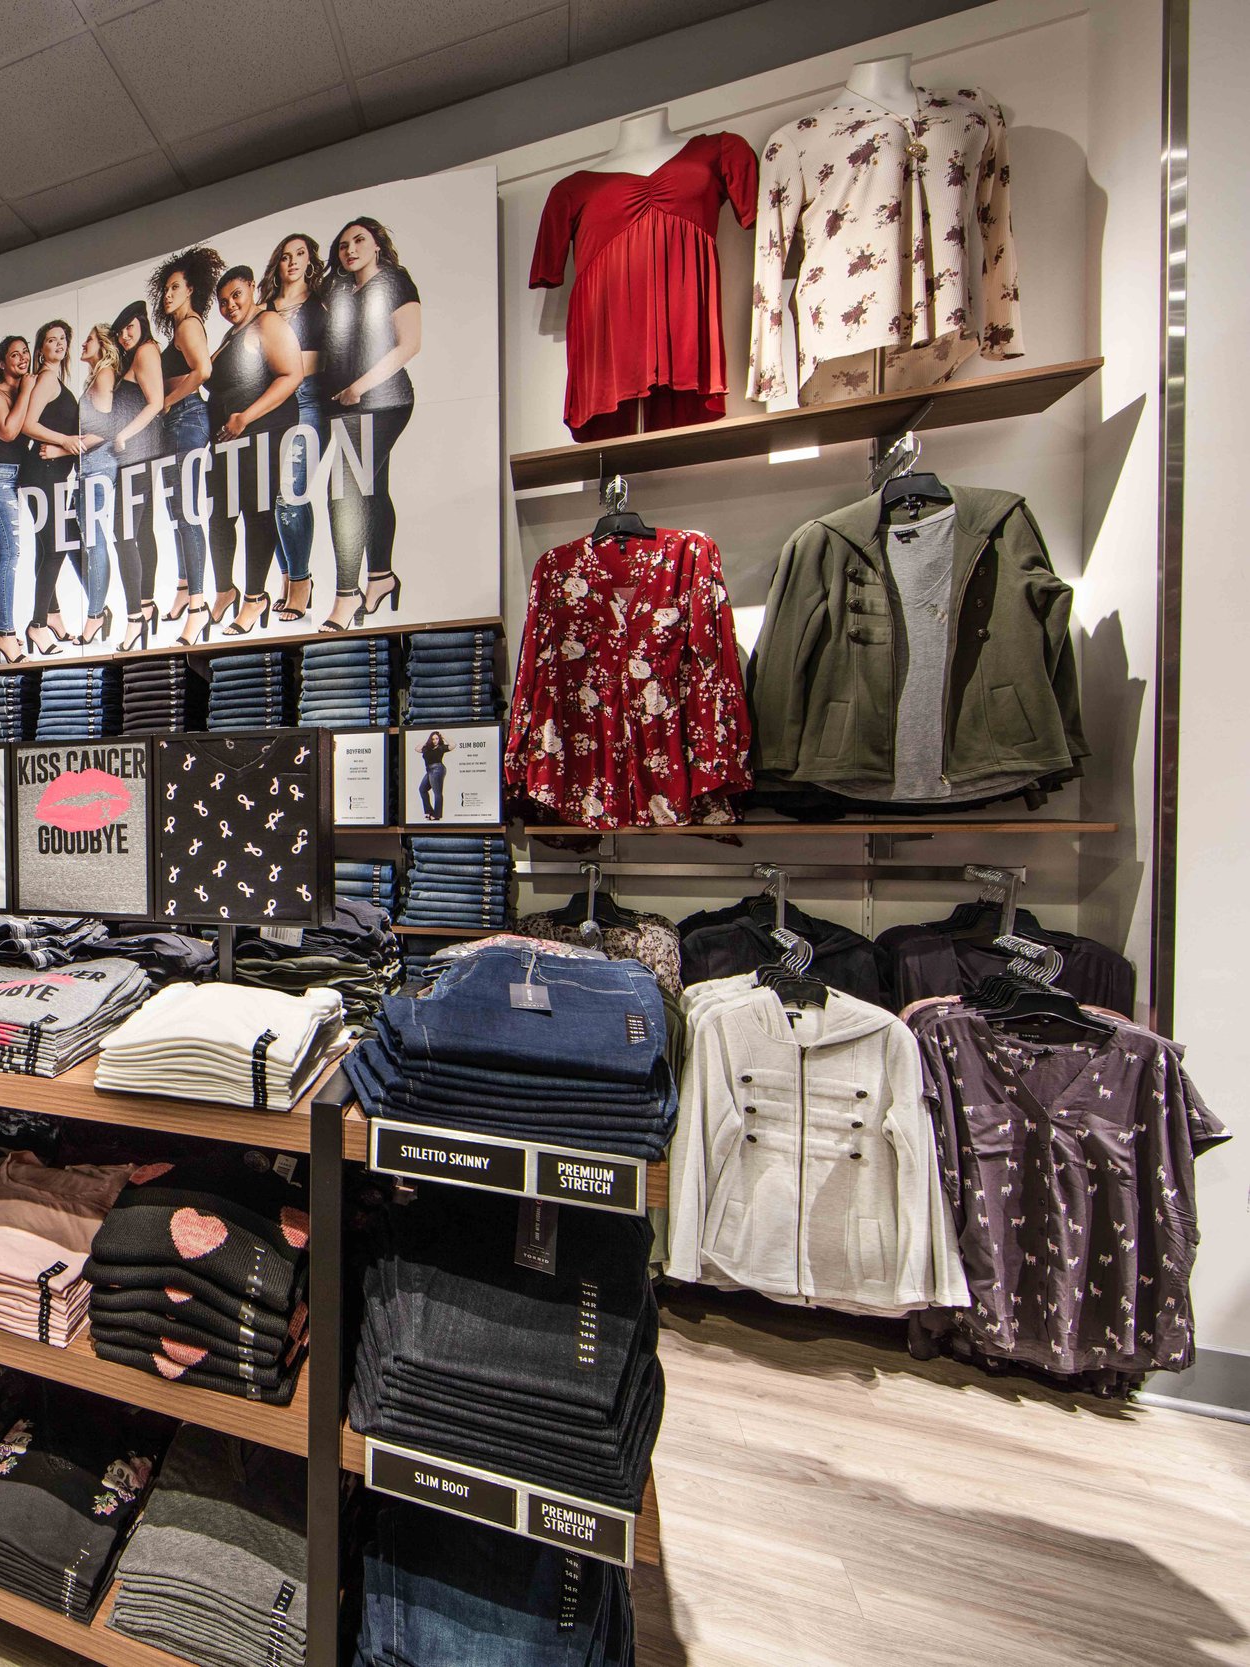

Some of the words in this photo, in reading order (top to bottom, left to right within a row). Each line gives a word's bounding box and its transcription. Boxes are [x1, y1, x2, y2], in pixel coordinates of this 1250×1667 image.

[16, 413, 376, 553] PERFECTION
[346, 747, 372, 755] BOYFRIEND
[17, 752, 61, 785] KISS
[65, 747, 146, 780] CANCER
[38, 823, 129, 855] GOODBYE
[400, 1145, 447, 1163] STILETTO
[449, 1152, 490, 1170] SKINNY
[558, 1162, 614, 1183] PREMIUM
[559, 1175, 611, 1195] STRETCH
[414, 1471, 439, 1489] SLIM
[442, 1480, 470, 1498] BOOT
[541, 1503, 596, 1530] PREMIUM
[543, 1516, 593, 1542] STRETCH
